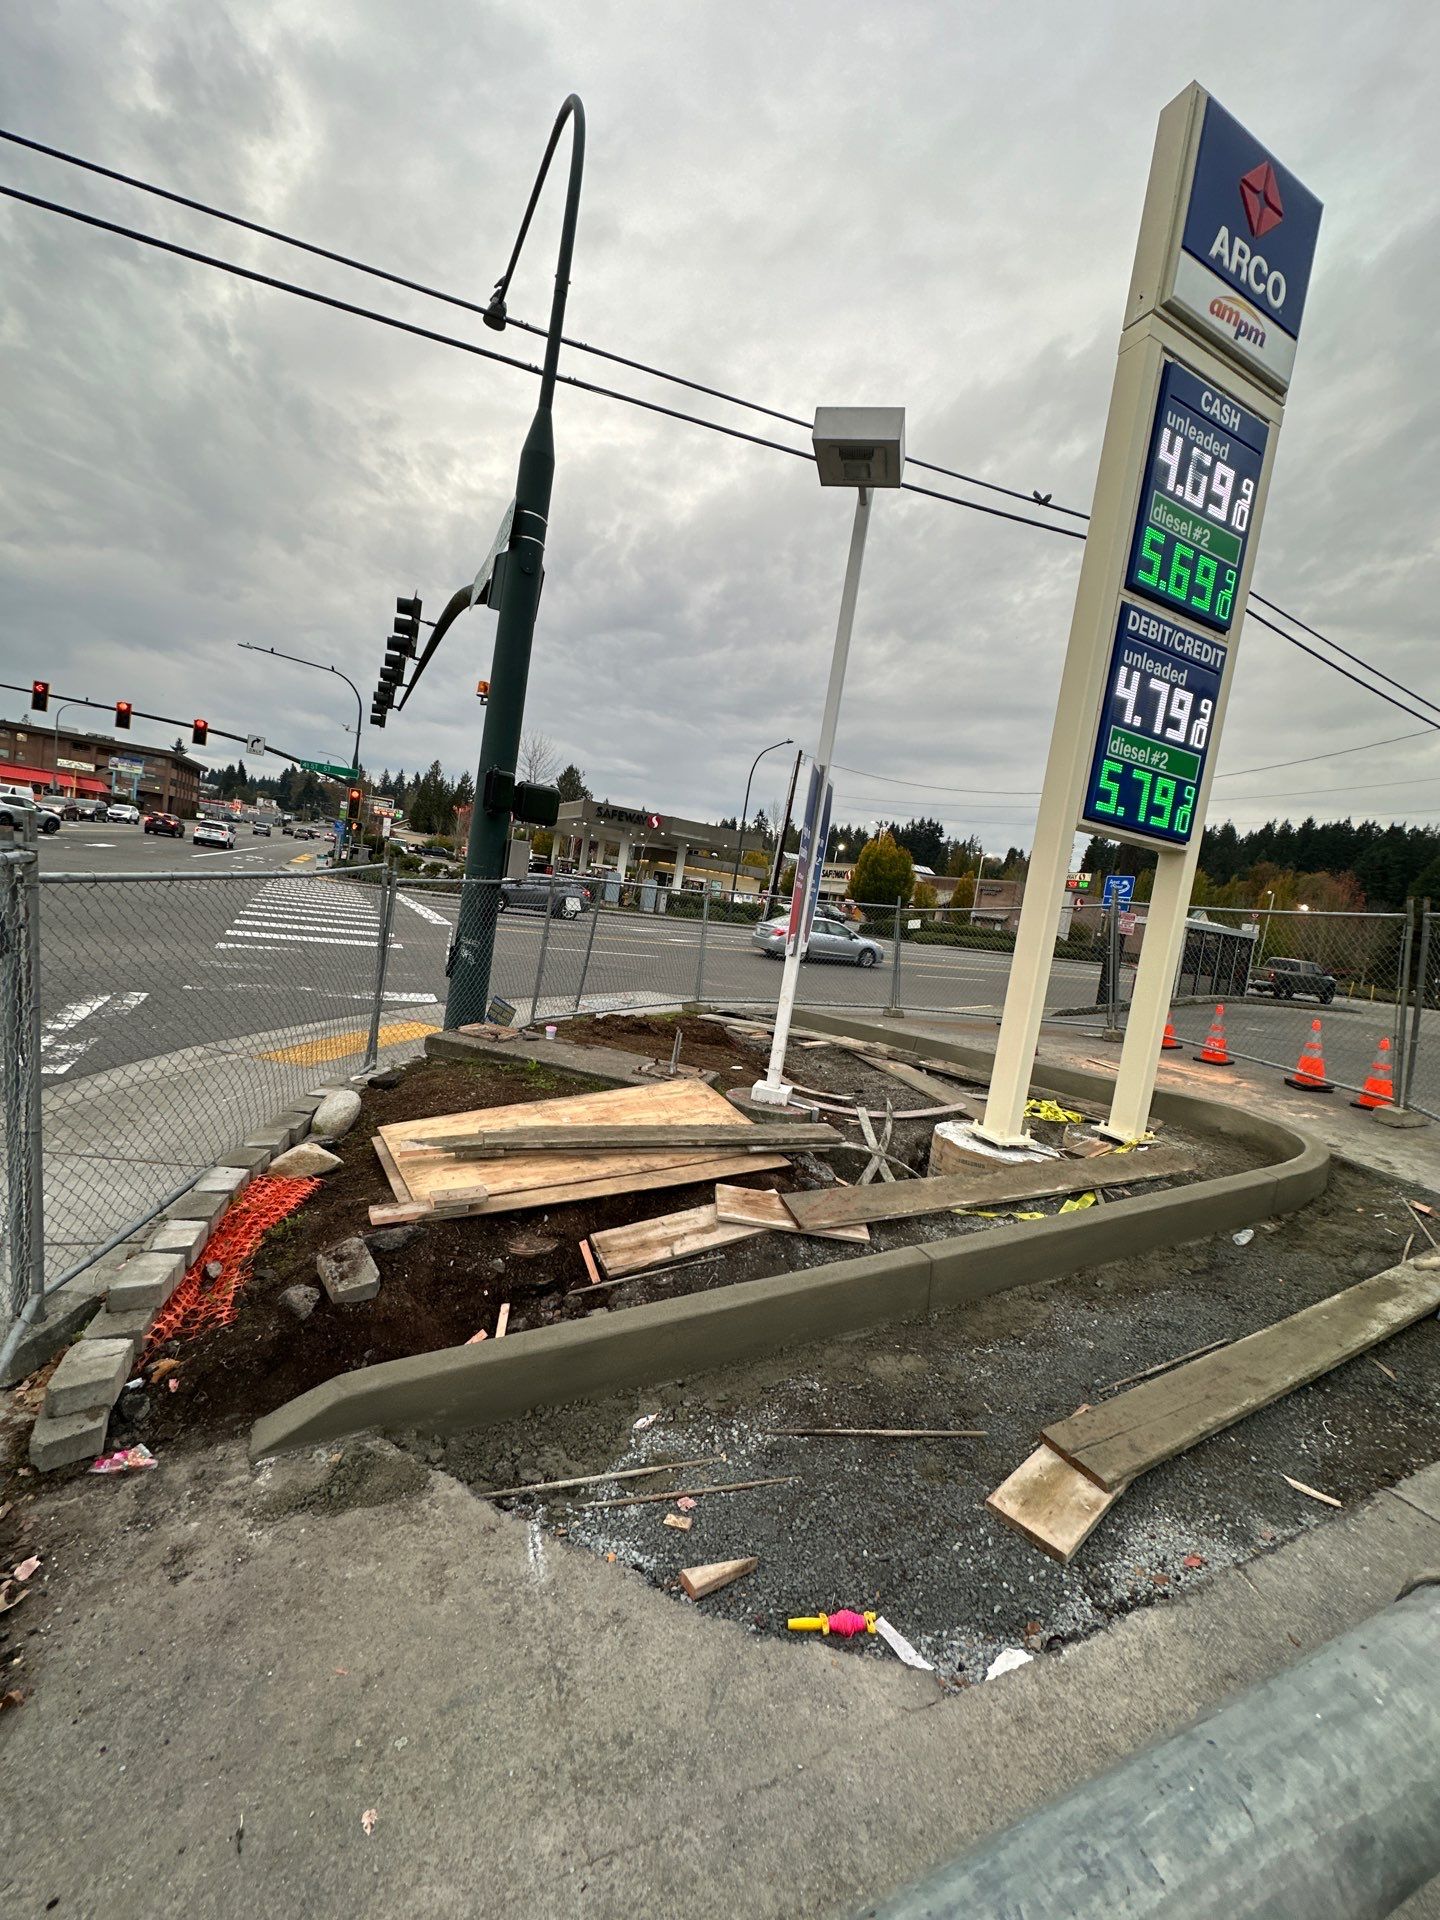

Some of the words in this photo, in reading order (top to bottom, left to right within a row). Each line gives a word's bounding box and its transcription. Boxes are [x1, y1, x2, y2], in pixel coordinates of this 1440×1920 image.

[1208, 225, 1287, 310] ARCO
[1209, 297, 1266, 348] ampm
[1166, 410, 1230, 462] unleaded
[1200, 391, 1241, 432] CASH
[1158, 427, 1236, 522] 4.69
[1153, 503, 1192, 539] diesel
[1192, 525, 1211, 548] #2
[1138, 525, 1218, 612] 5.69
[1127, 611, 1226, 669] DEBIT/CREDIT
[1123, 648, 1188, 687] unleaded
[1115, 665, 1194, 743] 4.79
[1110, 736, 1150, 766] diesel
[1150, 751, 1169, 770] #2
[595, 805, 648, 825] SAFEWAY
[1095, 758, 1177, 830] 5.79
